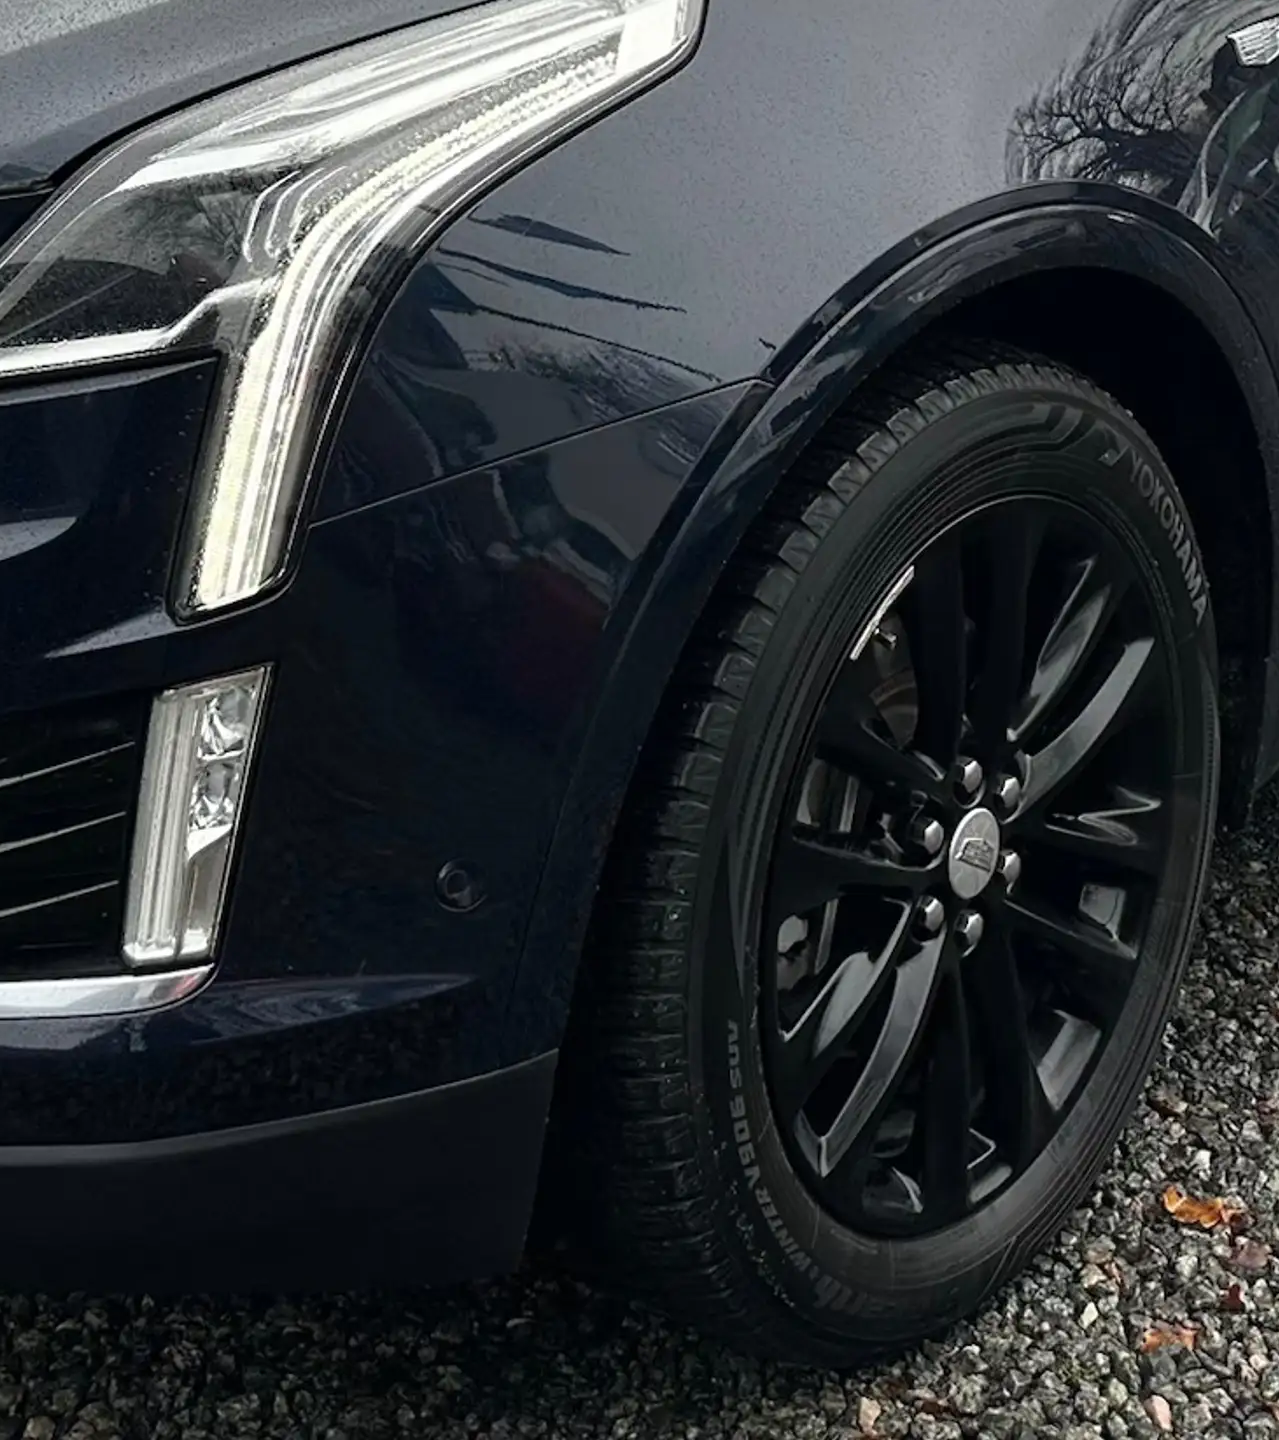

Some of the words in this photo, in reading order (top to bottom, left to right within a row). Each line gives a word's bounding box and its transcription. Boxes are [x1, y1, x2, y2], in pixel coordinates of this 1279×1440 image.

[1129, 447, 1207, 629] YOKOHAMA
[727, 1017, 744, 1090] SUV
[754, 1185, 813, 1273] WINTER
